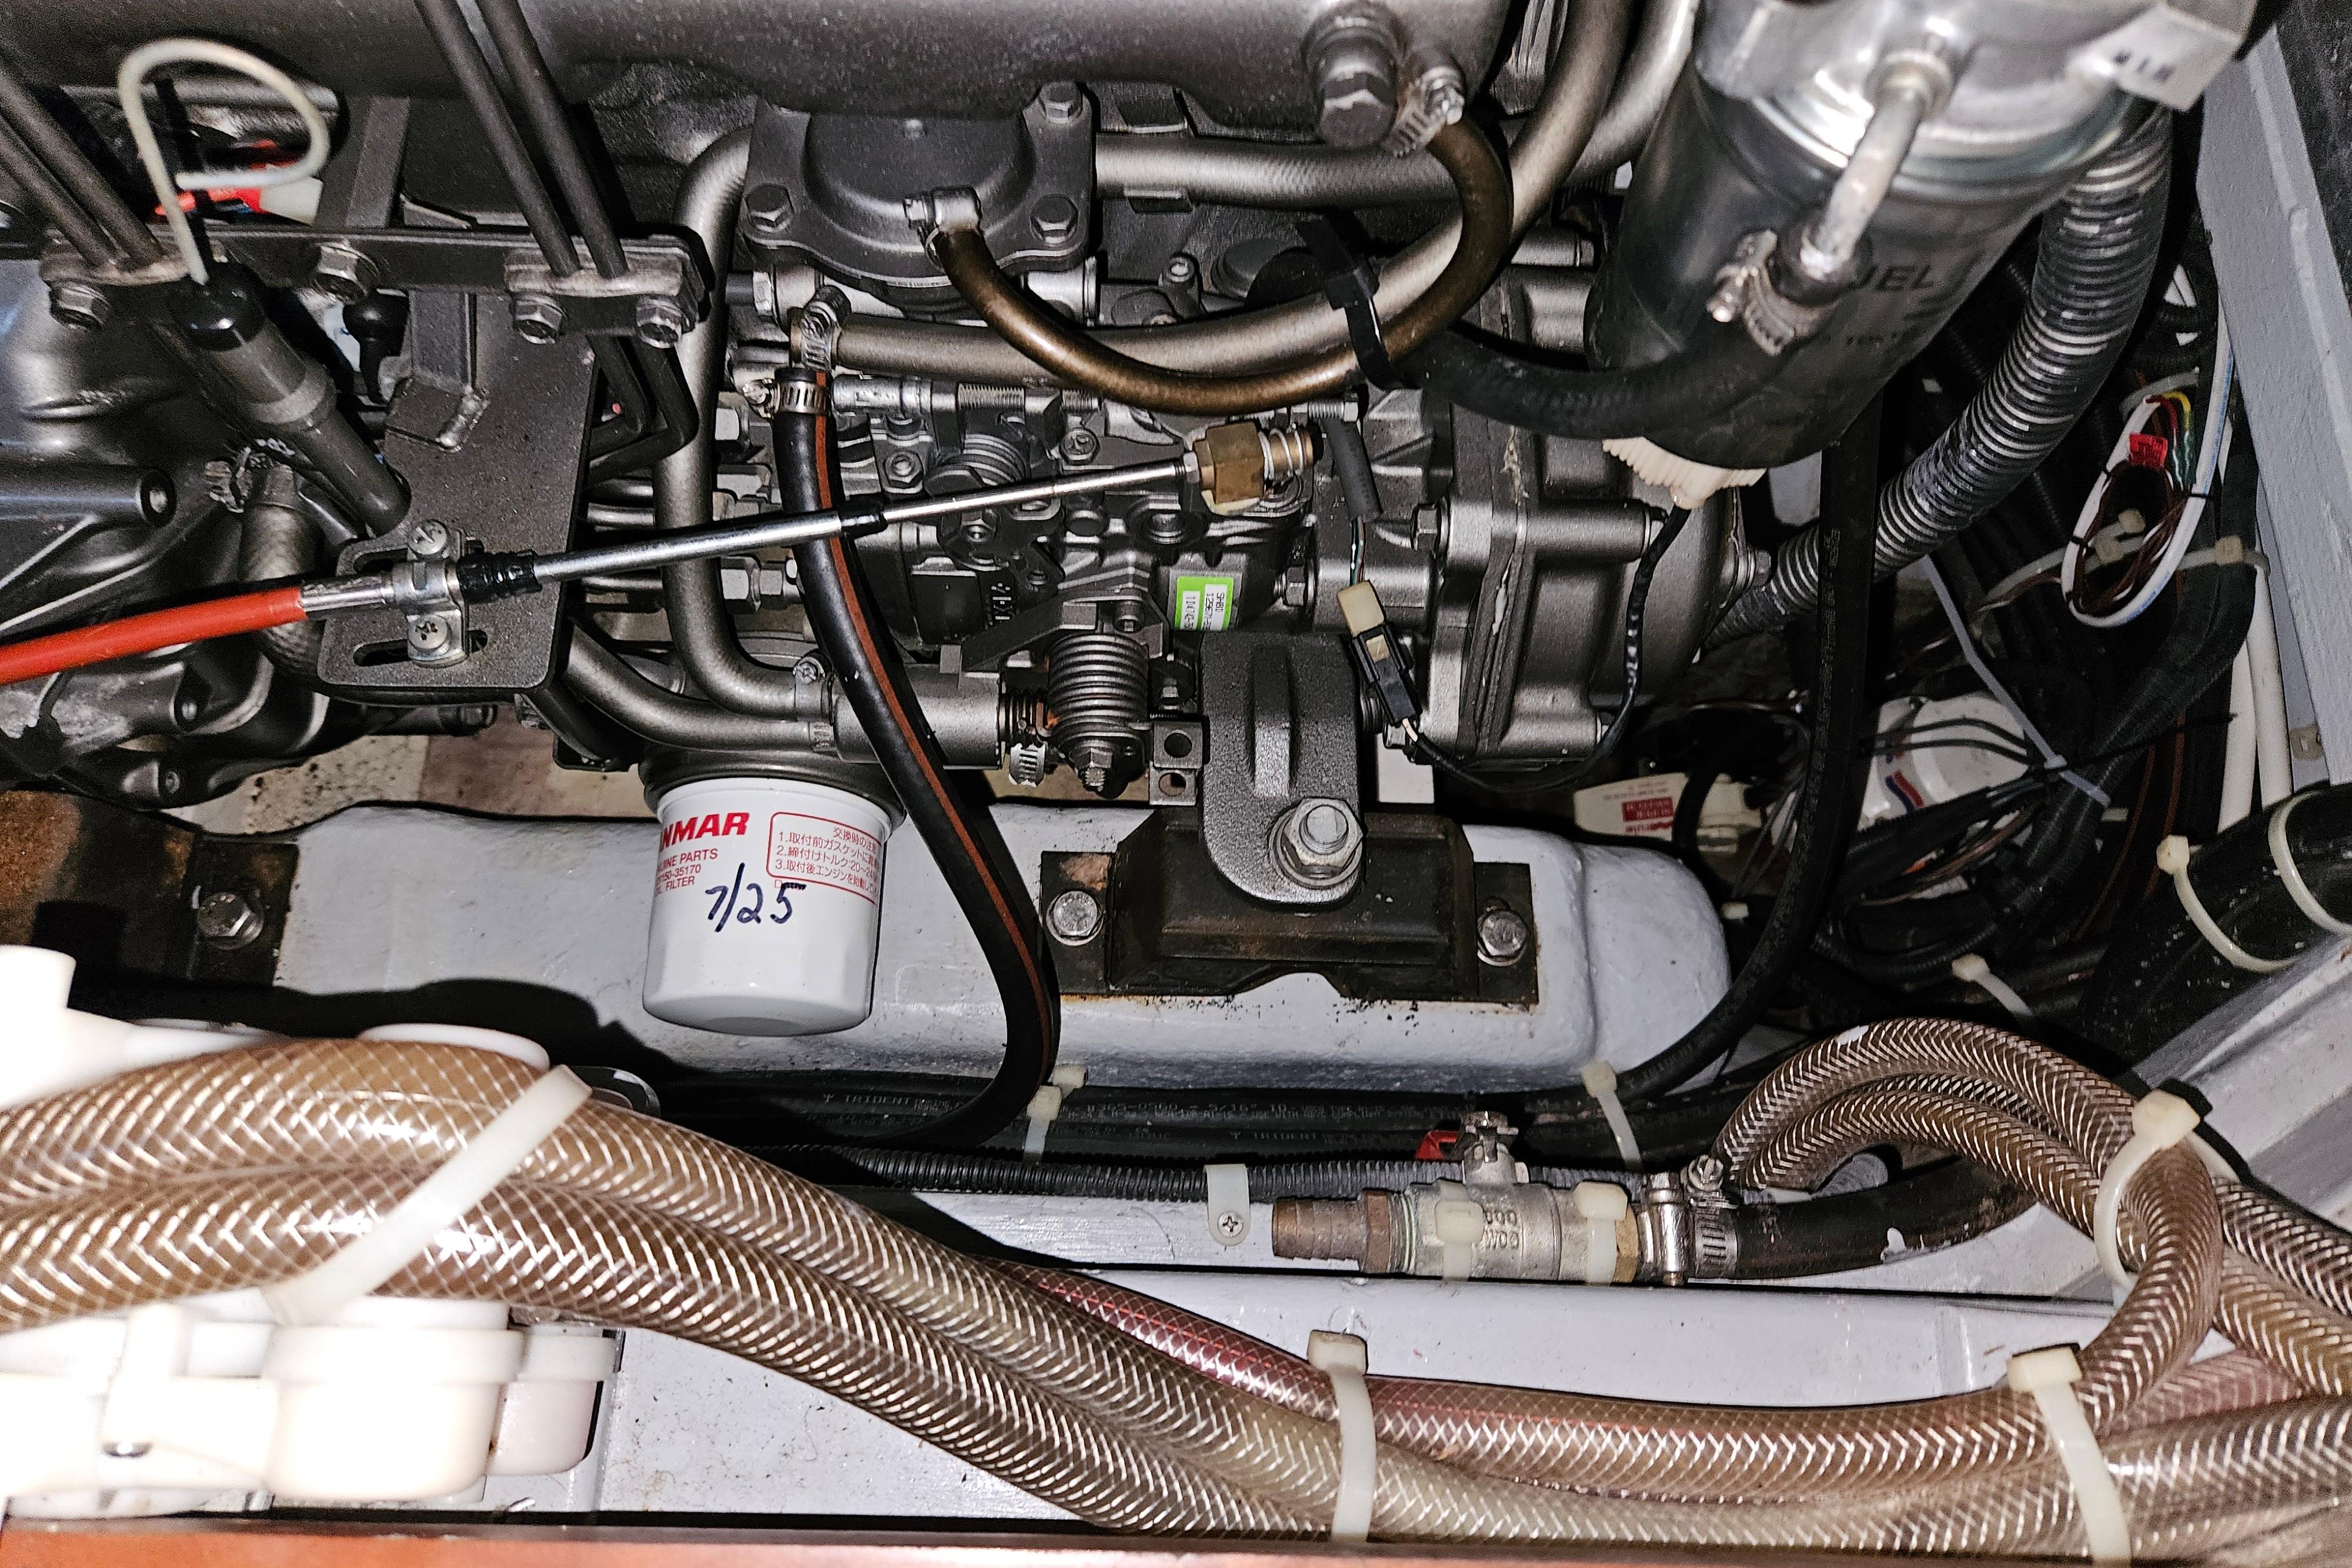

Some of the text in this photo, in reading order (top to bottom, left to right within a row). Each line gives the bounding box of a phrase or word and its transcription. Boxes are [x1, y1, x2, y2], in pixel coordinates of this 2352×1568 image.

[660, 813, 750, 852] NMAR
[680, 848, 718, 864] PARTS
[666, 876, 695, 891] FILTER
[705, 862, 807, 933] 7/25
[844, 1094, 911, 1104] TRIDENT
